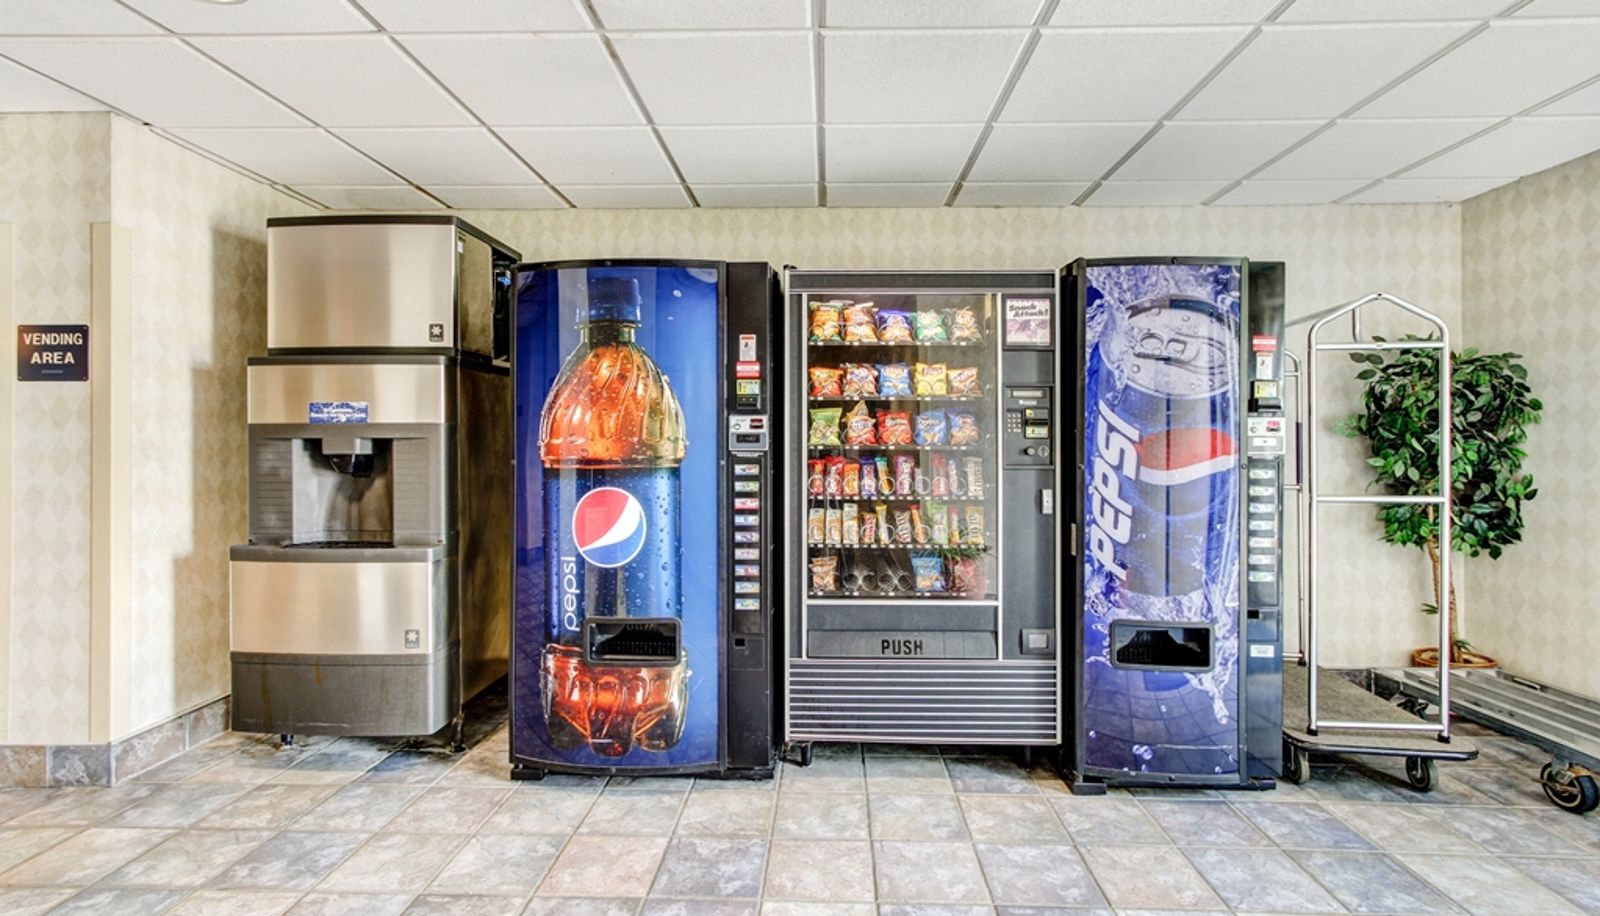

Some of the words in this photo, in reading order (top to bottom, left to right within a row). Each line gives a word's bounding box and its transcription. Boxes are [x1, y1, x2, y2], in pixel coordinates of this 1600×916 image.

[23, 332, 83, 345] VENDING
[30, 351, 75, 364] AREA
[1089, 398, 1140, 582] PEPSI
[560, 556, 581, 632] pepsi
[881, 639, 923, 656] PUSH
